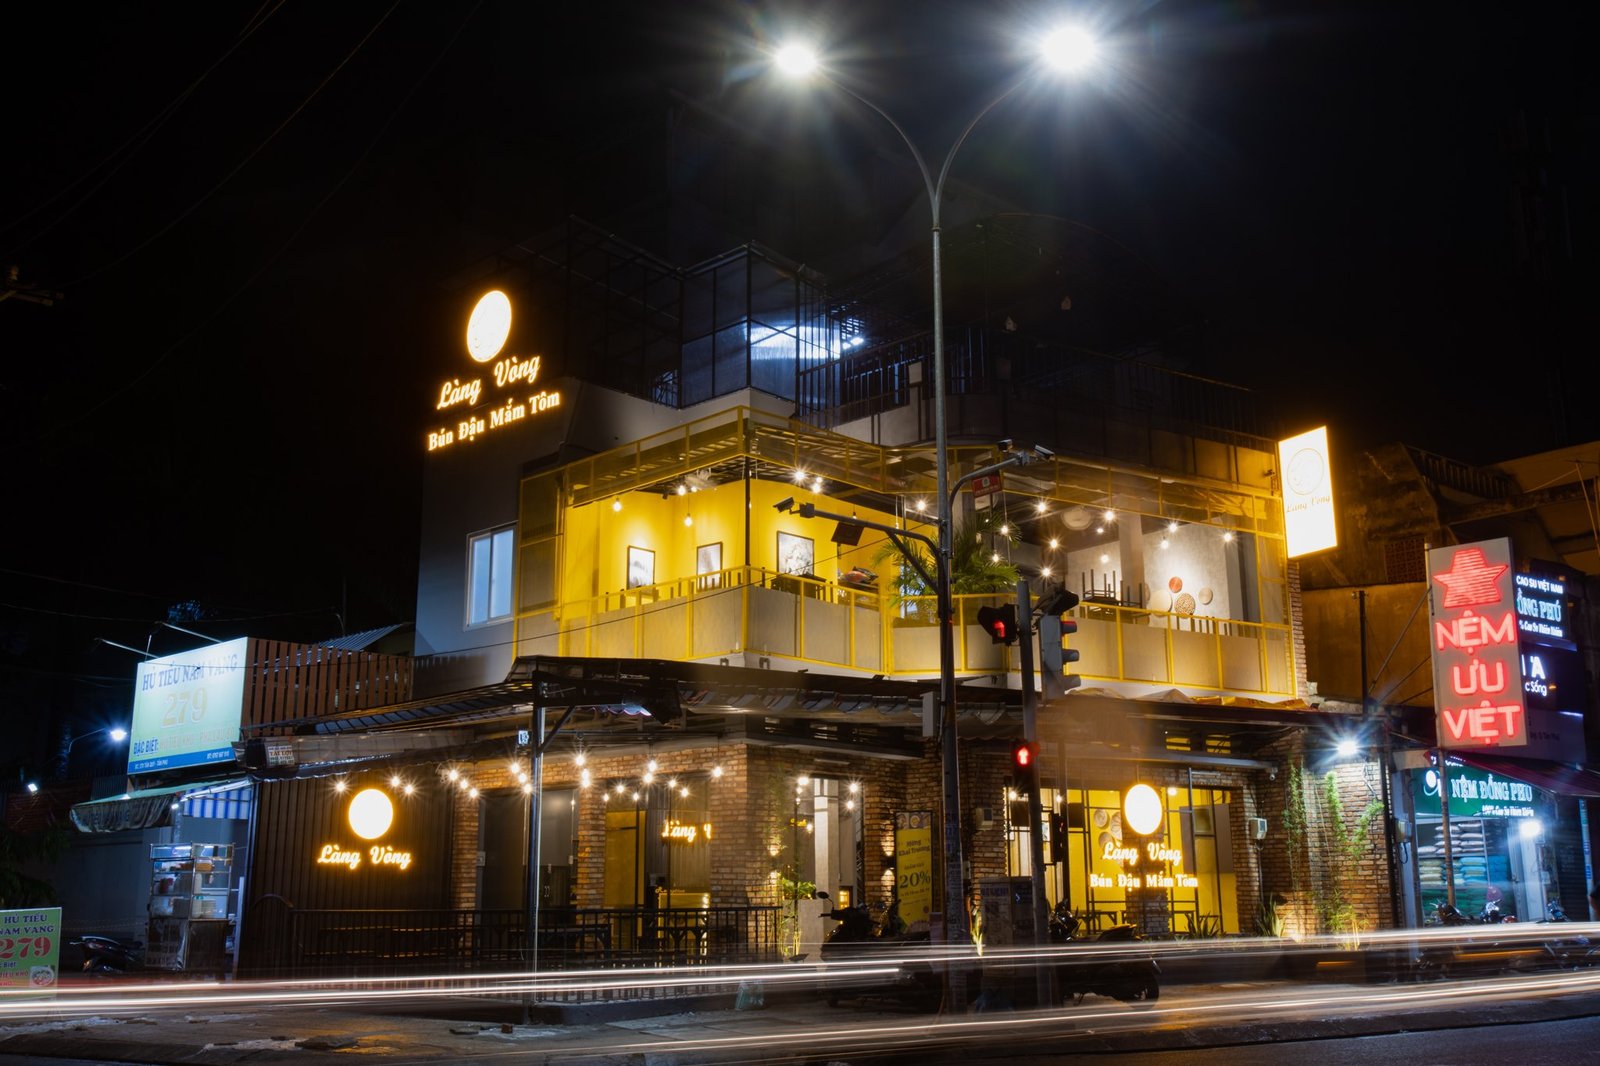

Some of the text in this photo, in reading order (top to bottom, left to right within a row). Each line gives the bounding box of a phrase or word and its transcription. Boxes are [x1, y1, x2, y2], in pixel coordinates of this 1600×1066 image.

[437, 355, 541, 410] Làng Vòng
[428, 391, 561, 451] Bún Đậu Mắm Tôm
[1516, 575, 1529, 587] CAO
[1529, 578, 1537, 588] SU
[1537, 579, 1550, 592] VIỆT
[1516, 588, 1561, 622] ỒNG PHÚ
[1435, 610, 1516, 654] NỆM
[182, 663, 204, 683] NAM
[1453, 659, 1504, 695] ƯU
[1530, 680, 1547, 697] Sống
[161, 687, 208, 727] 279
[1443, 700, 1520, 744] VIỆT
[1451, 774, 1478, 803] NỆM
[1479, 773, 1509, 801] ĐỒNG
[317, 844, 411, 870] Làng Vòng
[1103, 841, 1182, 866] Làng Vòng
[899, 870, 931, 889] 20%
[1089, 871, 1199, 892] Bún Đậu Mắm Tôm
[23, 913, 47, 924] TIẾU
[24, 925, 54, 933] VANG
[0, 936, 51, 959] 279
